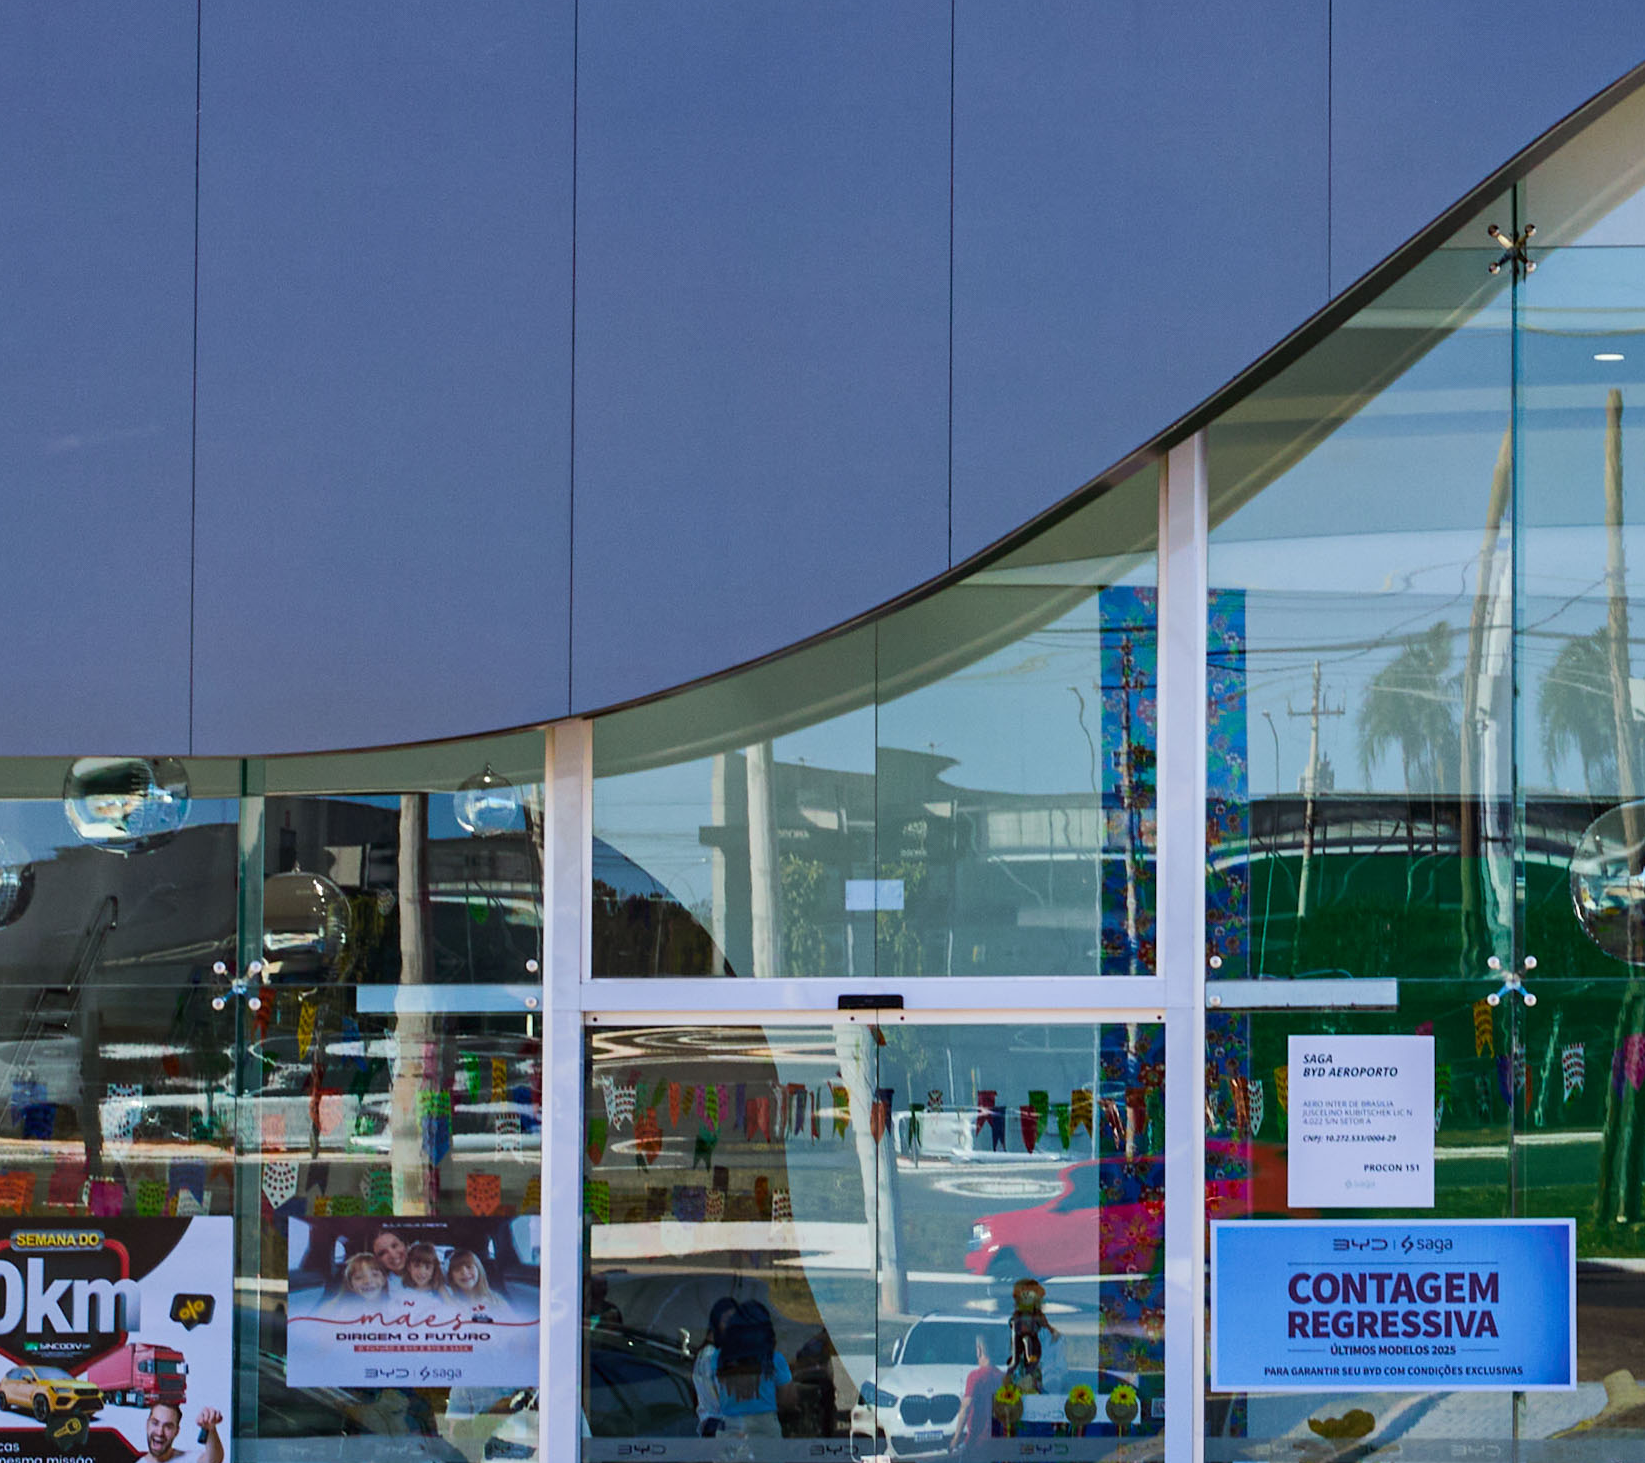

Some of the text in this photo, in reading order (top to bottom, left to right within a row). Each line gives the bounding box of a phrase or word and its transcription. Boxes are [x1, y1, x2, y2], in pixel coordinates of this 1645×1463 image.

[1303, 1054, 1333, 1064] SAGA
[1303, 1067, 1398, 1077] BYD AEROPORTO
[1364, 1164, 1420, 1172] PROCON 151
[16, 1233, 99, 1246] SEMANA DO
[1333, 1238, 1453, 1254] BYD saga
[1288, 1272, 1499, 1304] CONTAGEM
[356, 1300, 462, 1331] mães
[1288, 1310, 1499, 1338] REGRESSIVA
[336, 1333, 491, 1341] DIRIGEM O FUTURO
[1330, 1342, 1456, 1355] ÚLTIMOS MODELOS 2025
[365, 1368, 462, 1381] BYD saga
[1264, 1363, 1523, 1378] PARA GARANTIR SEU BYD COM CONDIÇÕES EXCLUSIVAS
[618, 1444, 666, 1456] BYD
[809, 1444, 859, 1456] BYD
